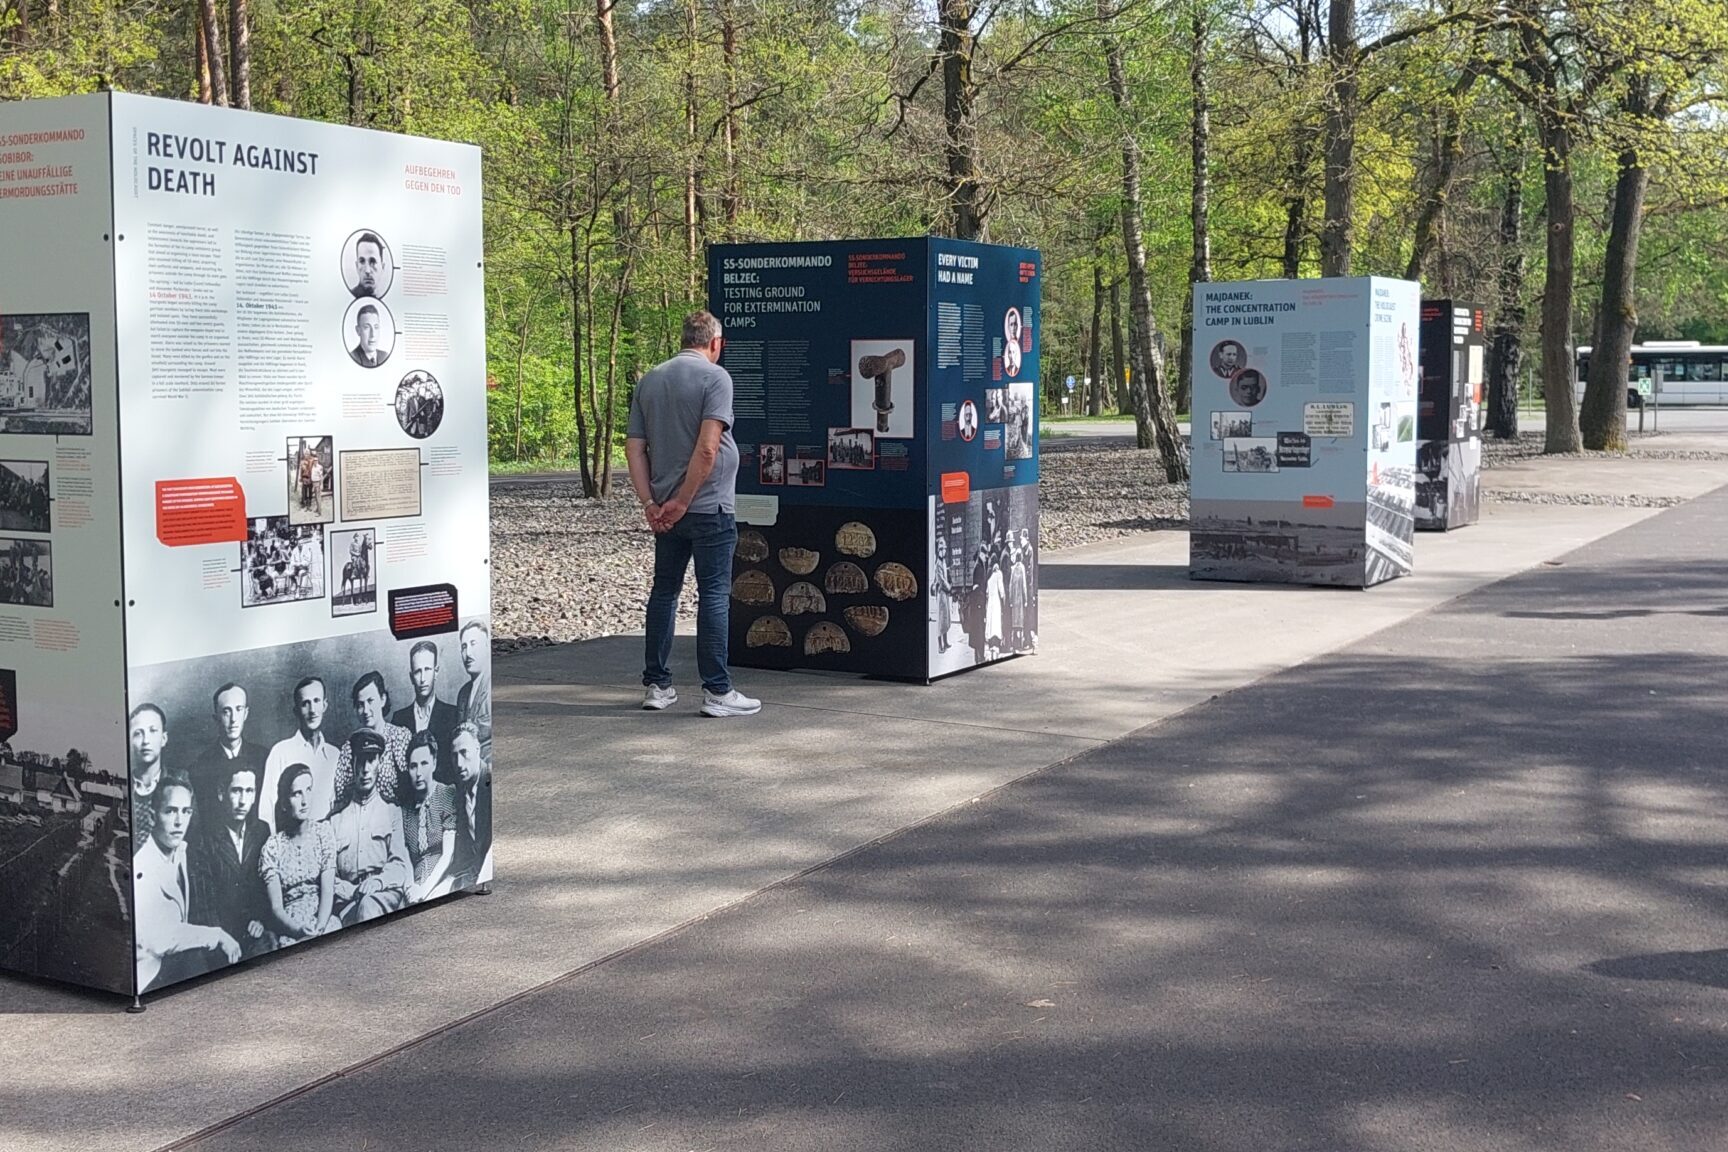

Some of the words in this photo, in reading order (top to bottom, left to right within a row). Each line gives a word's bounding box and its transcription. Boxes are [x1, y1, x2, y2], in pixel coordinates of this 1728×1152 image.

[0, 152, 34, 165] OBIBOR:
[147, 132, 227, 164] REVOLT
[233, 143, 319, 175] AGAINST
[17, 165, 73, 180] UNAUFFÄLLIGE
[405, 164, 456, 180] AUFBEGEHREN
[148, 167, 216, 196] DEATH
[405, 180, 429, 192] GEGEN
[431, 183, 445, 193] DEN
[447, 185, 461, 195] TOD
[724, 256, 832, 269] SS-SONDERKOMMANDO
[938, 253, 957, 267] EVERY
[958, 256, 979, 269] VICTIM
[724, 273, 760, 284] BELZEC:
[938, 270, 951, 283] HAD
[951, 272, 956, 284] A
[957, 273, 974, 285] NAME
[724, 287, 762, 299] TESTING
[765, 286, 805, 298] GROUND
[1206, 292, 1253, 303] MAJDANEK:
[724, 302, 742, 313] FOR
[744, 301, 821, 313] EXTERMINATION
[1206, 305, 1222, 314] THE
[1223, 303, 1296, 314] CONCENTRATION
[724, 316, 756, 328] CAMPS
[1206, 317, 1230, 326] CAMP
[1231, 317, 1241, 326] IN
[1243, 316, 1275, 326] LUBLIN
